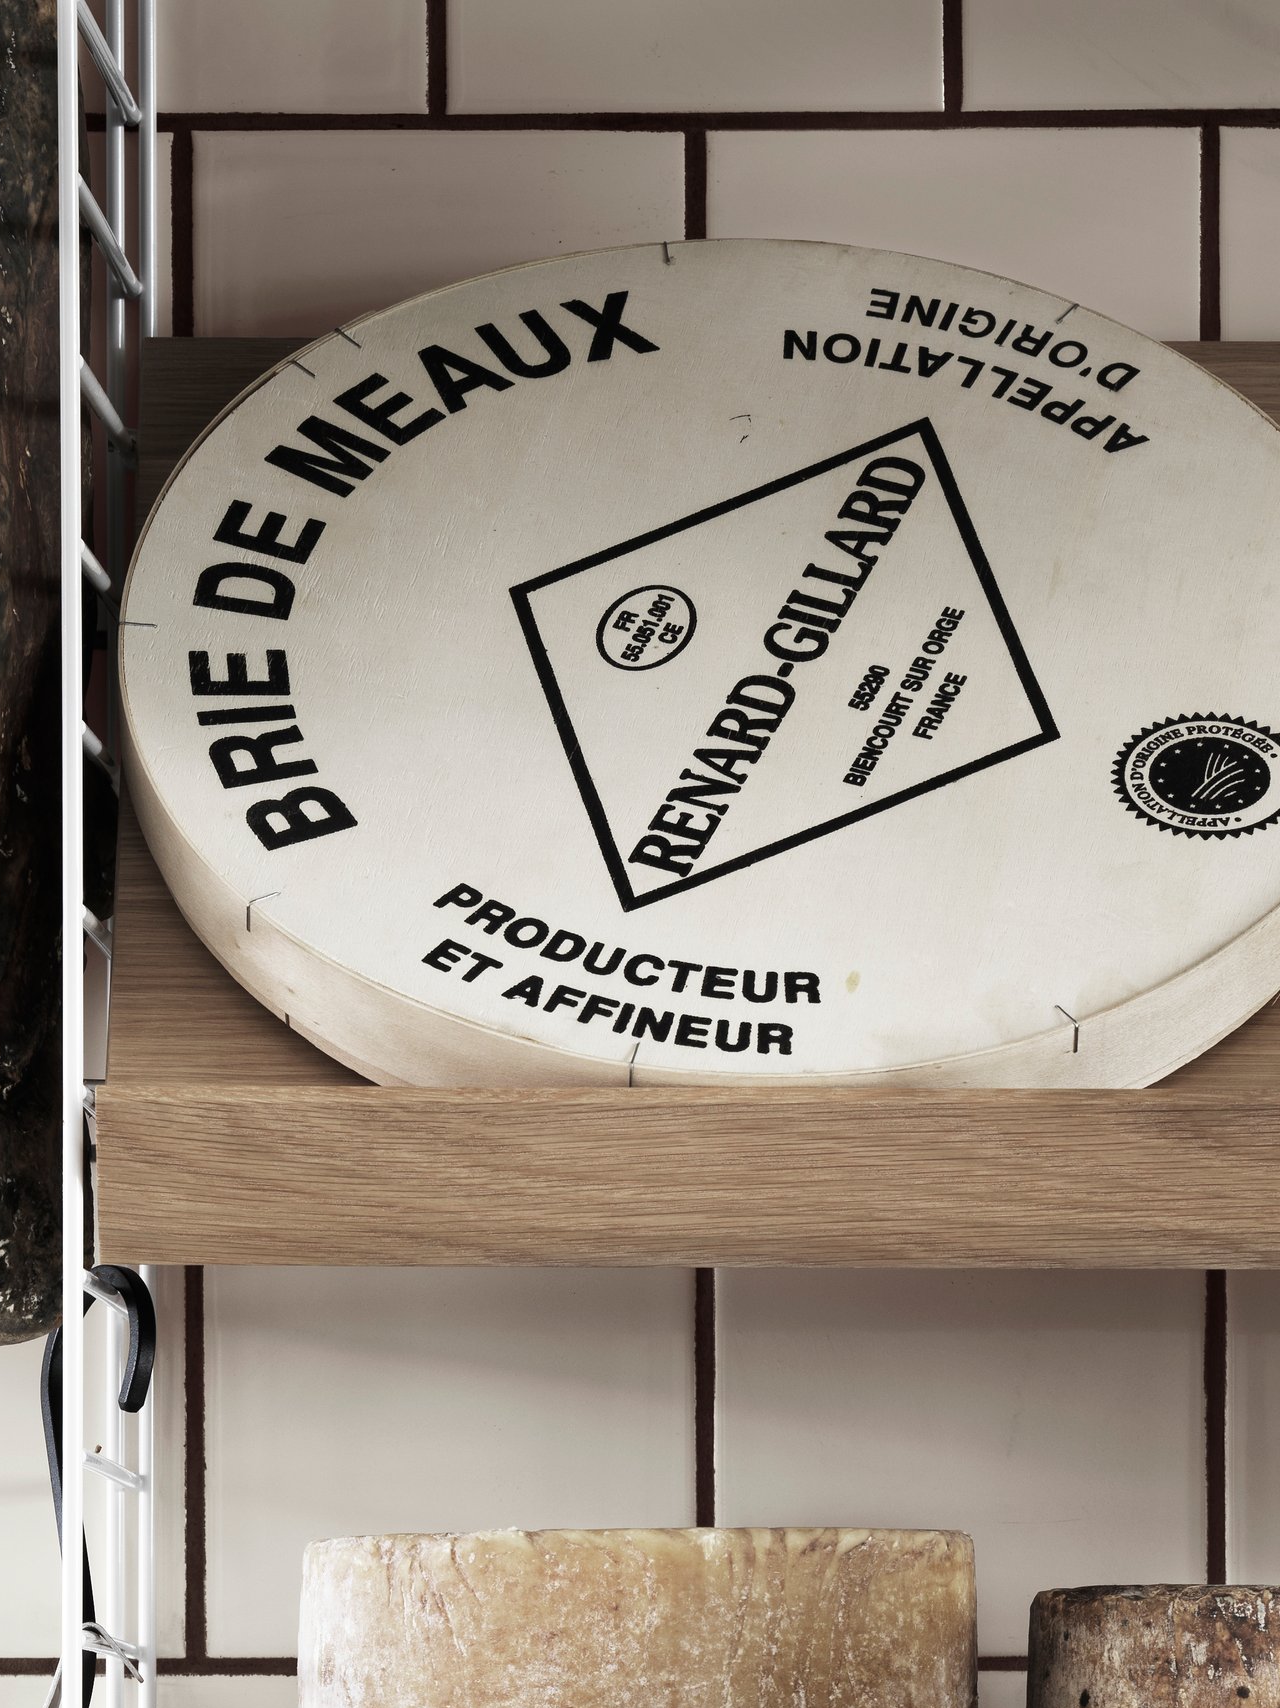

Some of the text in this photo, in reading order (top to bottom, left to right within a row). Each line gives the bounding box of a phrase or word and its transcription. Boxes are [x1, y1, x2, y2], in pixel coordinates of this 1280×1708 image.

[783, 330, 1150, 453] APPELLATION
[866, 288, 1140, 392] D'ORIGINE
[189, 291, 660, 851] BRIE DE MEAUX
[612, 610, 640, 633] FR
[620, 593, 676, 662] 55.051.001
[628, 457, 925, 877] RENARD-GILLARD
[658, 622, 684, 644] CE
[842, 606, 966, 787] BIENCOURT SUR ORGE
[848, 665, 890, 711] 55290
[912, 671, 968, 740] FRANCE
[1130, 725, 1274, 827] APPELLATION D'ORIGINE PROTÉGÉE
[433, 883, 821, 1003] PRODUCTEUR
[422, 939, 793, 1055] ET AFFINEUR
